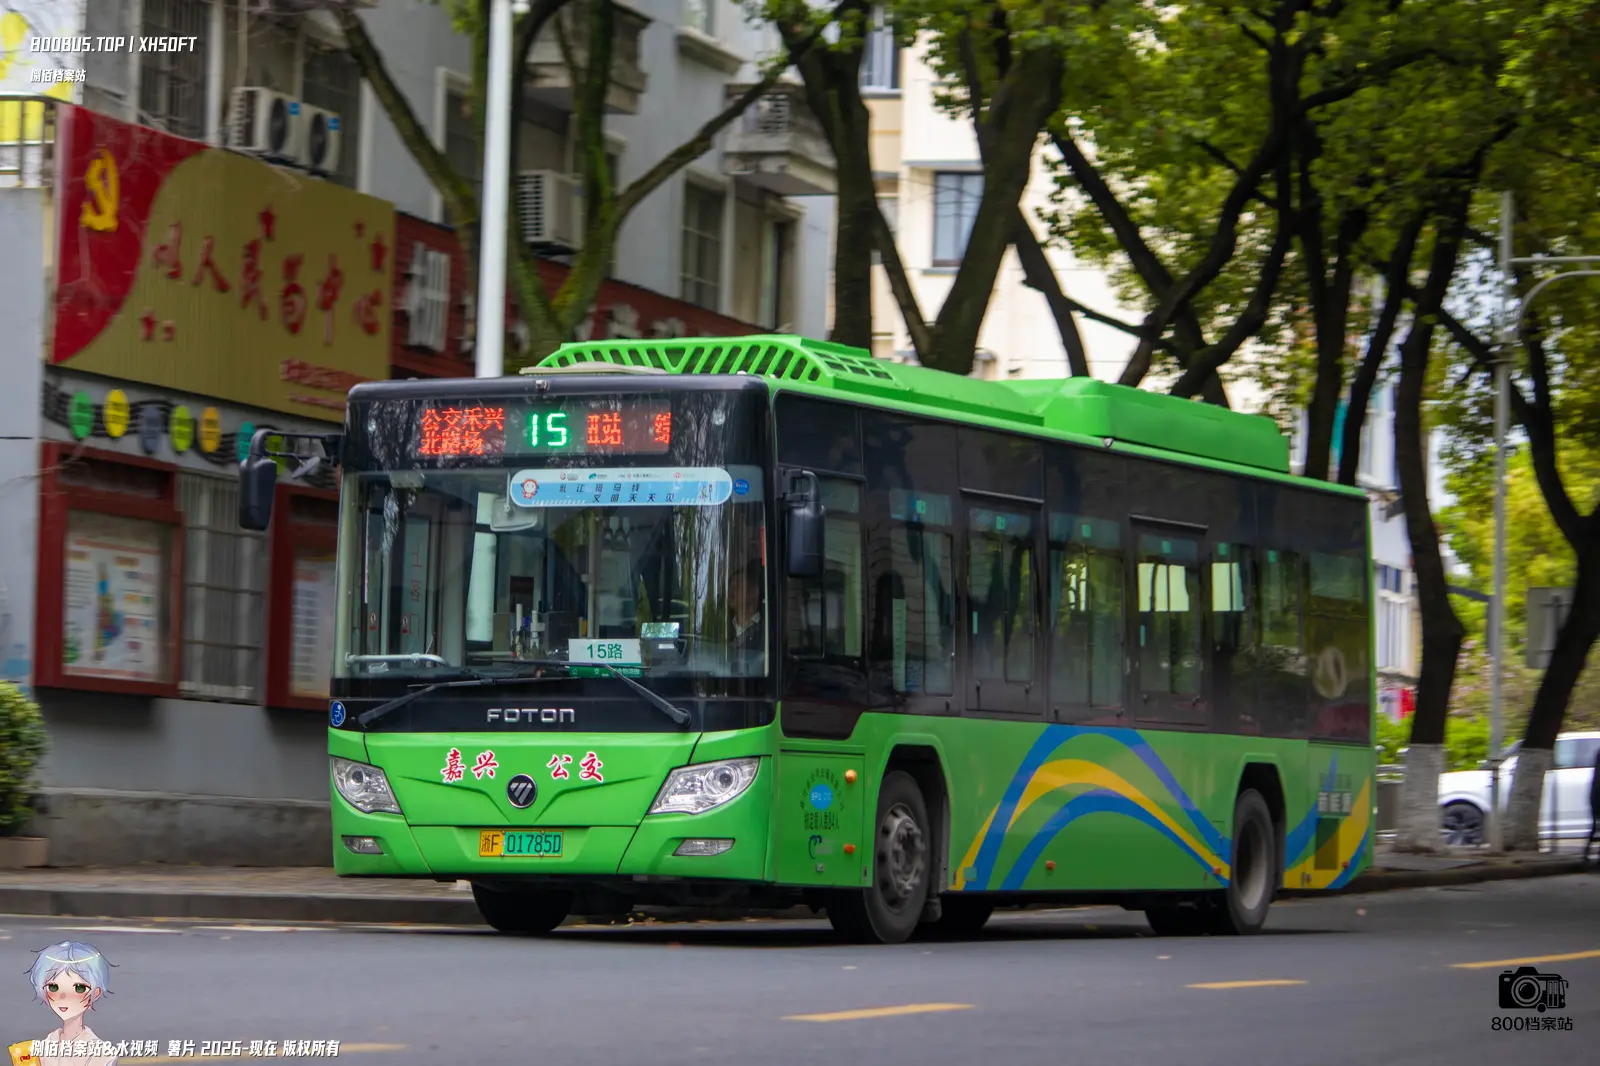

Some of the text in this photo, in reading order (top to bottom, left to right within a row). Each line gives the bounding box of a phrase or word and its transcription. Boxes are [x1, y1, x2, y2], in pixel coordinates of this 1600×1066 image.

[531, 413, 568, 447] 15
[586, 643, 623, 660] 15路
[487, 708, 575, 723] FOTON
[440, 747, 604, 783] 嘉兴 公交
[507, 834, 562, 853] 01785D
